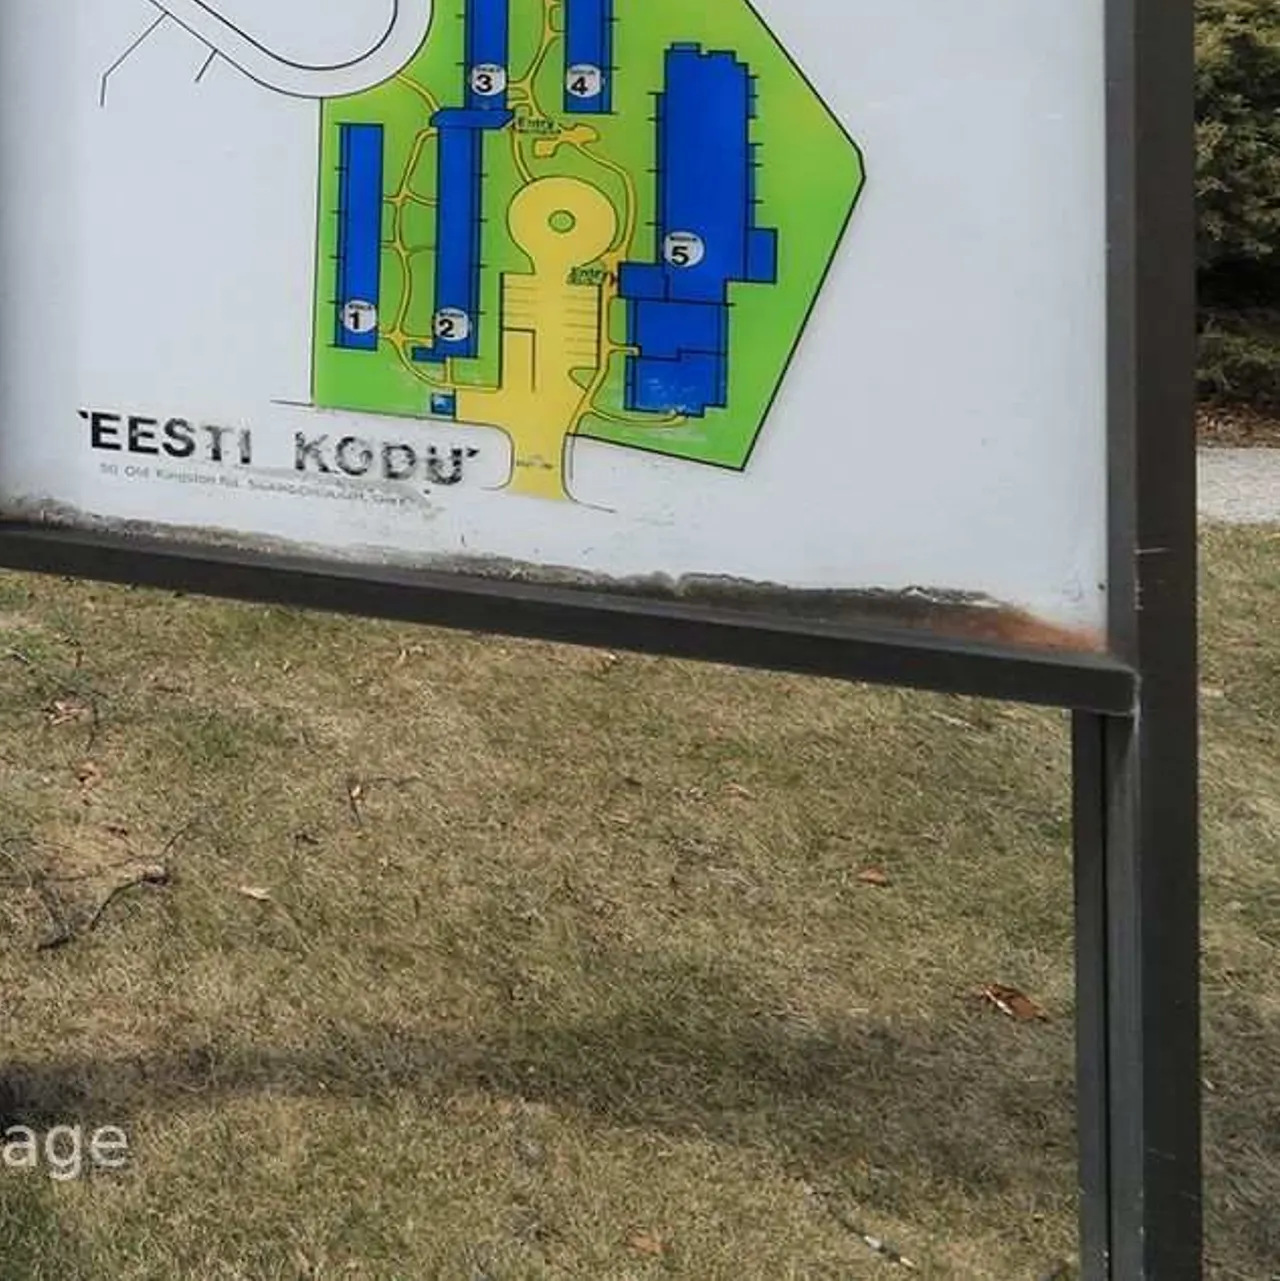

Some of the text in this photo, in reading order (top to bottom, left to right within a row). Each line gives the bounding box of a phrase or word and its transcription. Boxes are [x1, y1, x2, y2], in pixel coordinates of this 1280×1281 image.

[474, 74, 493, 93] 3
[570, 76, 588, 95] 4
[671, 245, 690, 266] 5
[349, 310, 360, 330] 1
[438, 318, 455, 338] 2
